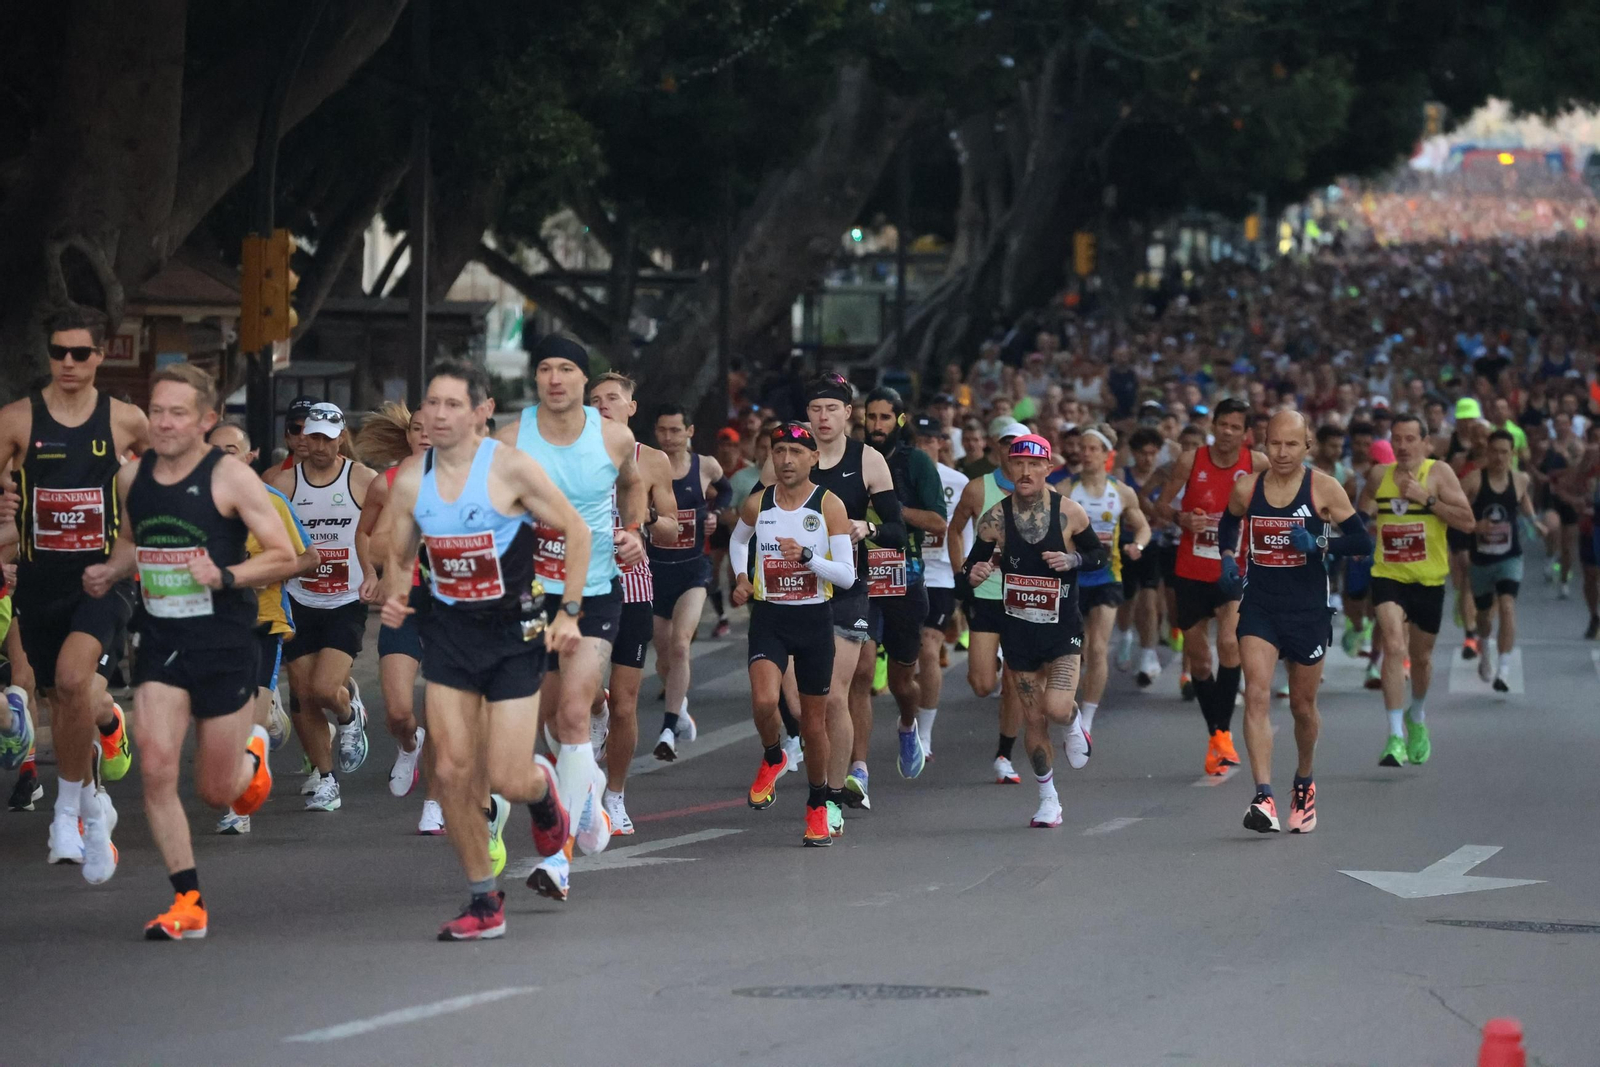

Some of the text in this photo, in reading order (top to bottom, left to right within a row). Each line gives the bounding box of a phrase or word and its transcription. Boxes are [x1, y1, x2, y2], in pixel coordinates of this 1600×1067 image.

[51, 491, 98, 503] GENERALI
[51, 511, 86, 524] 7022
[310, 533, 339, 541] RIMOR
[438, 535, 490, 550] GENERALI
[1263, 534, 1291, 546] 6256
[442, 558, 477, 572] 3921
[777, 576, 805, 587] 1054
[1019, 578, 1056, 588] GENERALI
[1015, 591, 1048, 604] 10449
